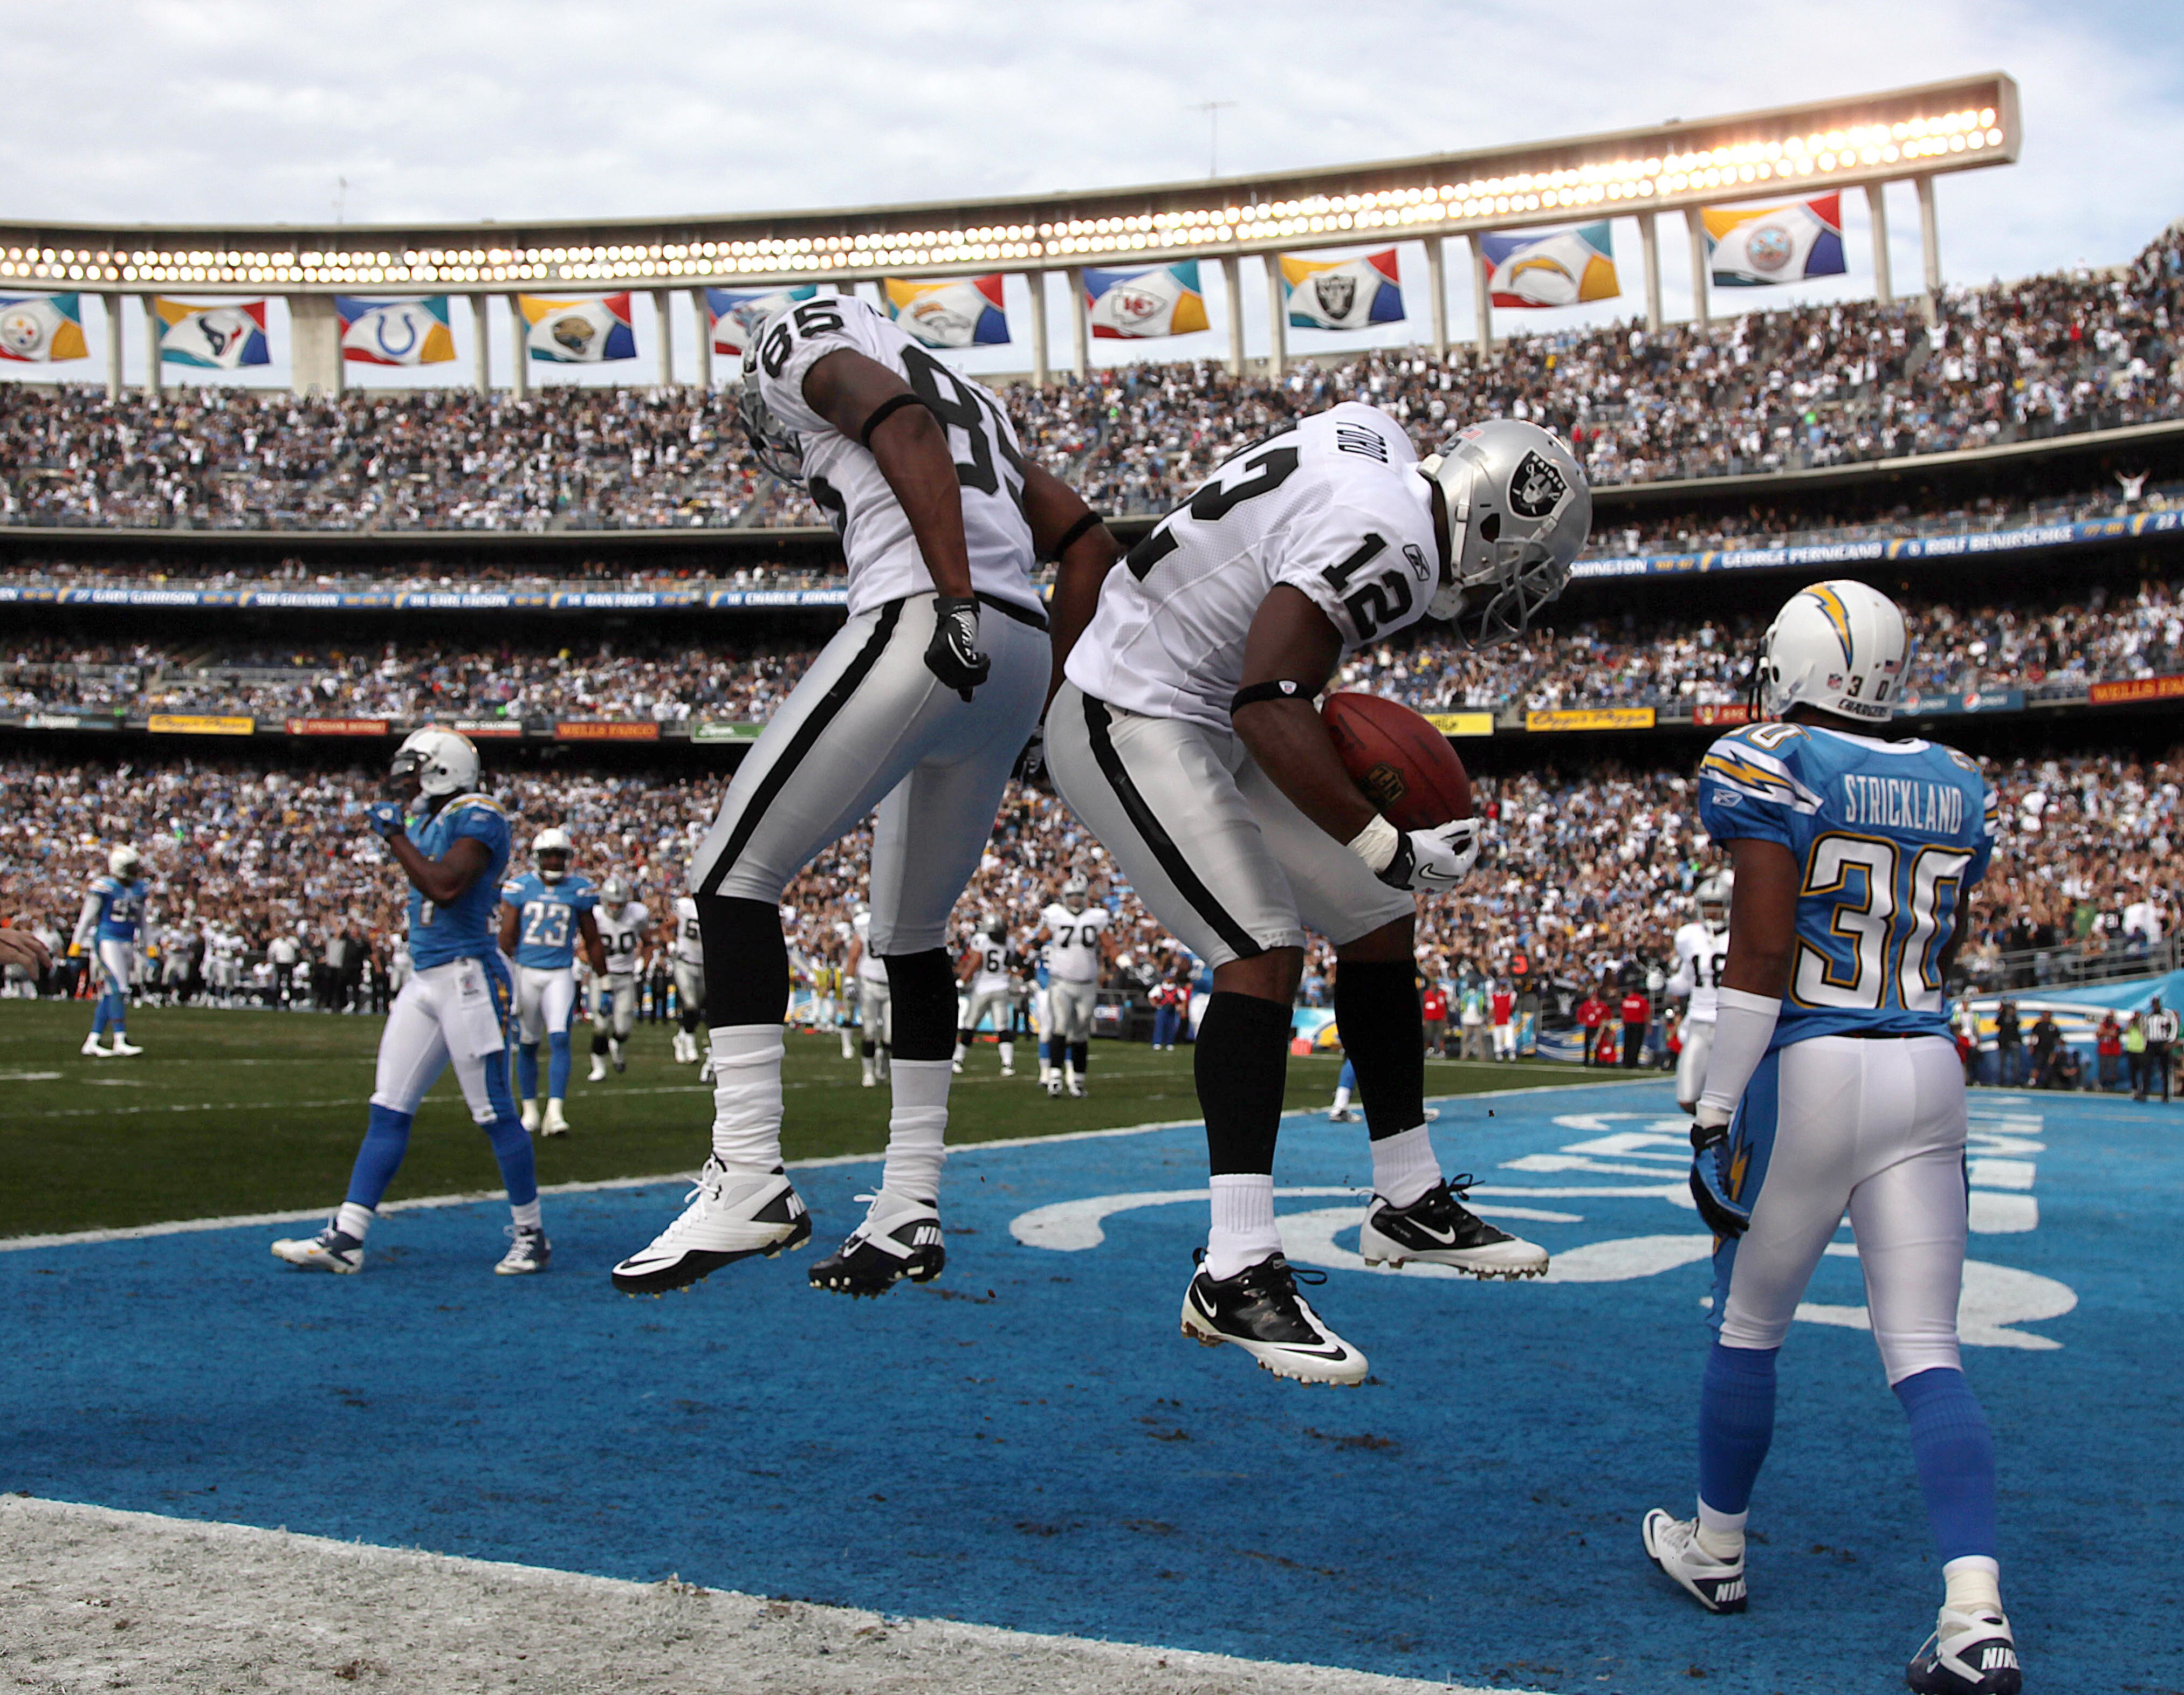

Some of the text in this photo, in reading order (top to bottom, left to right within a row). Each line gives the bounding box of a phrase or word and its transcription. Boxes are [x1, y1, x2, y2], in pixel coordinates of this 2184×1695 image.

[762, 300, 844, 378] 85
[1321, 534, 1411, 640] 12
[1844, 773, 1963, 835] STRICKLAND
[521, 900, 572, 948] 23
[1060, 925, 1096, 948] 70
[1512, 955, 1528, 974] 3
